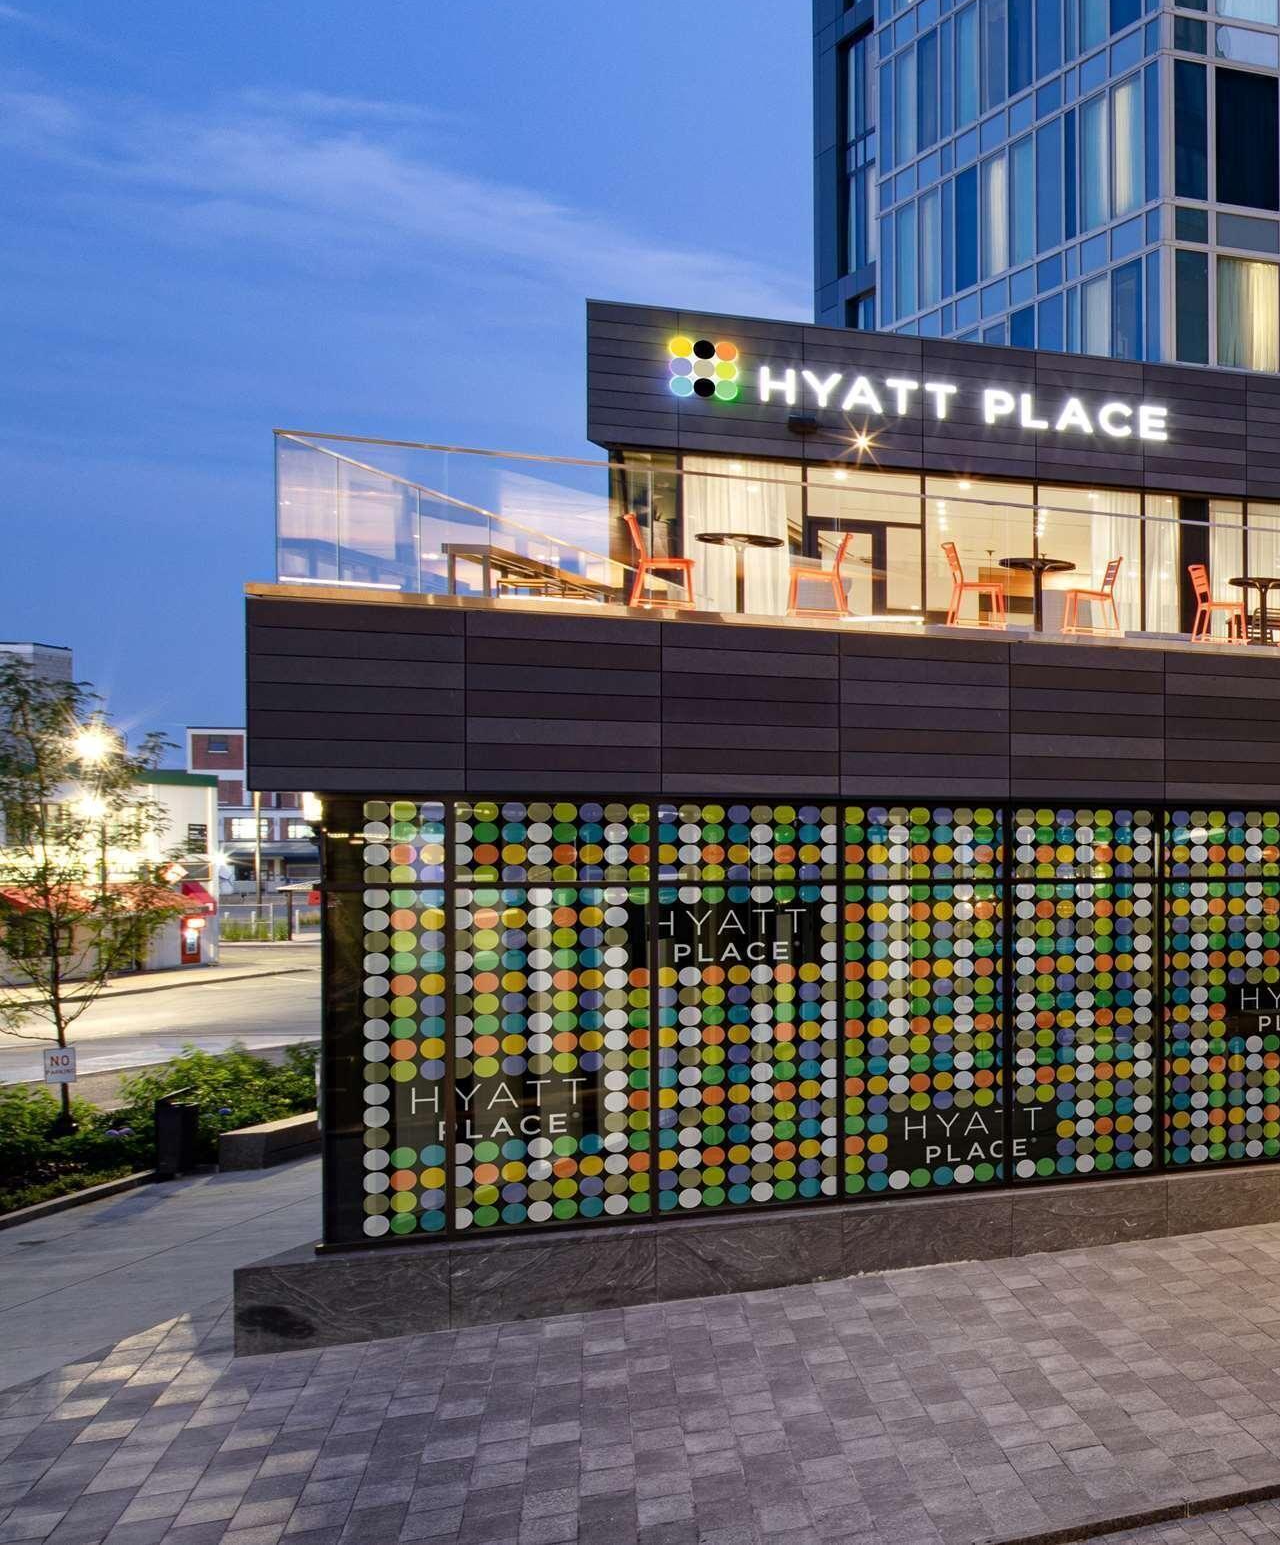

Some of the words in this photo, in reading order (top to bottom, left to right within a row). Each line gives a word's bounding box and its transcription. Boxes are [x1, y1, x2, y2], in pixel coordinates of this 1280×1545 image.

[759, 365, 957, 419] HYATT
[983, 388, 1168, 441] PLACE
[674, 942, 789, 963] PLACE
[50, 1055, 70, 1066] NO
[411, 1078, 587, 1114] HYATT
[904, 1107, 1043, 1140] HYAT
[926, 1139, 1027, 1164] PLACE
